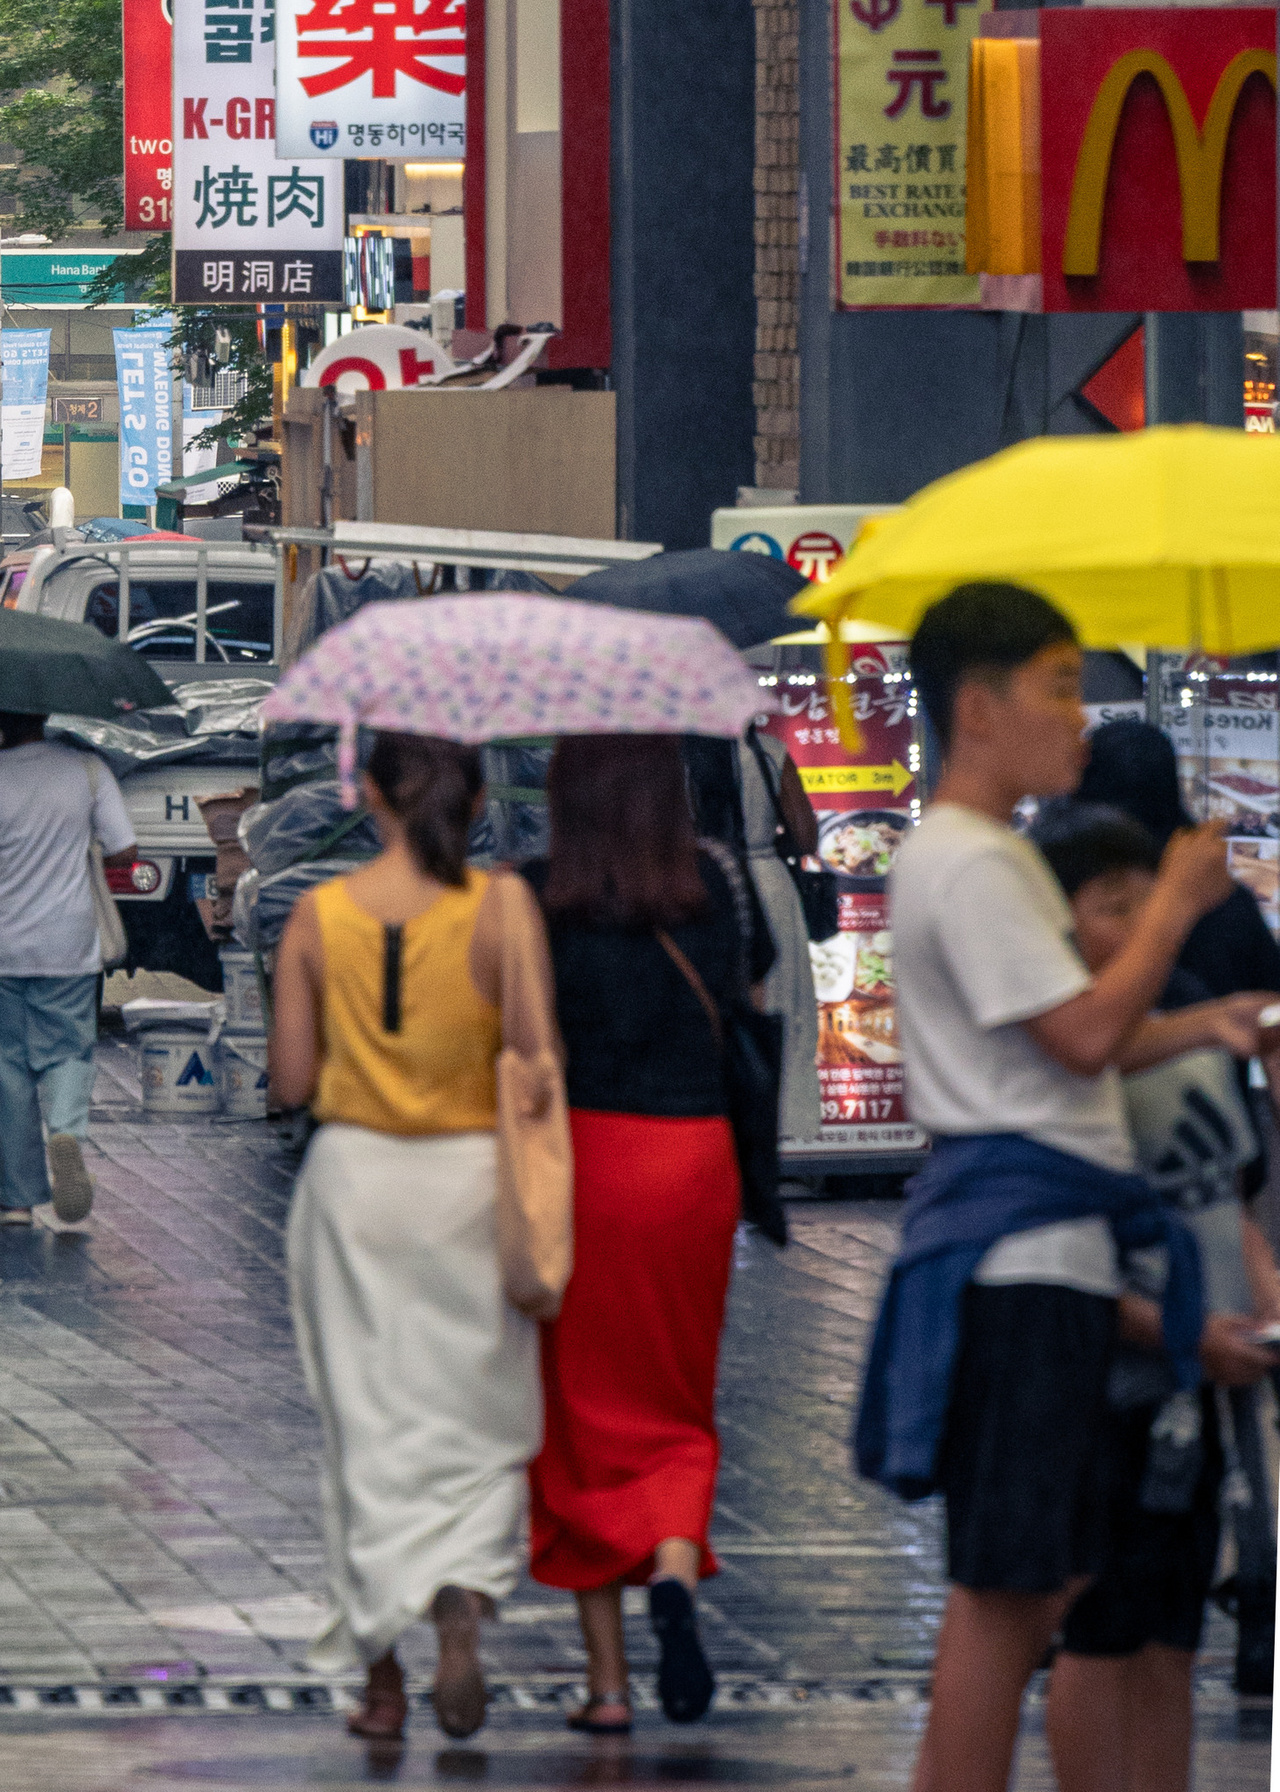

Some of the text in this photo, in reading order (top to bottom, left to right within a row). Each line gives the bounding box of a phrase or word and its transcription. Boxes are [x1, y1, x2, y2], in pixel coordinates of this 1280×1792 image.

[884, 49, 951, 120] 元
[183, 97, 275, 141] K-GR
[348, 122, 465, 149] 명동하이약국
[850, 184, 957, 199] BEST RATE
[863, 202, 966, 218] EXCHANG
[51, 264, 80, 276] Hana
[202, 260, 314, 294] 明洞店
